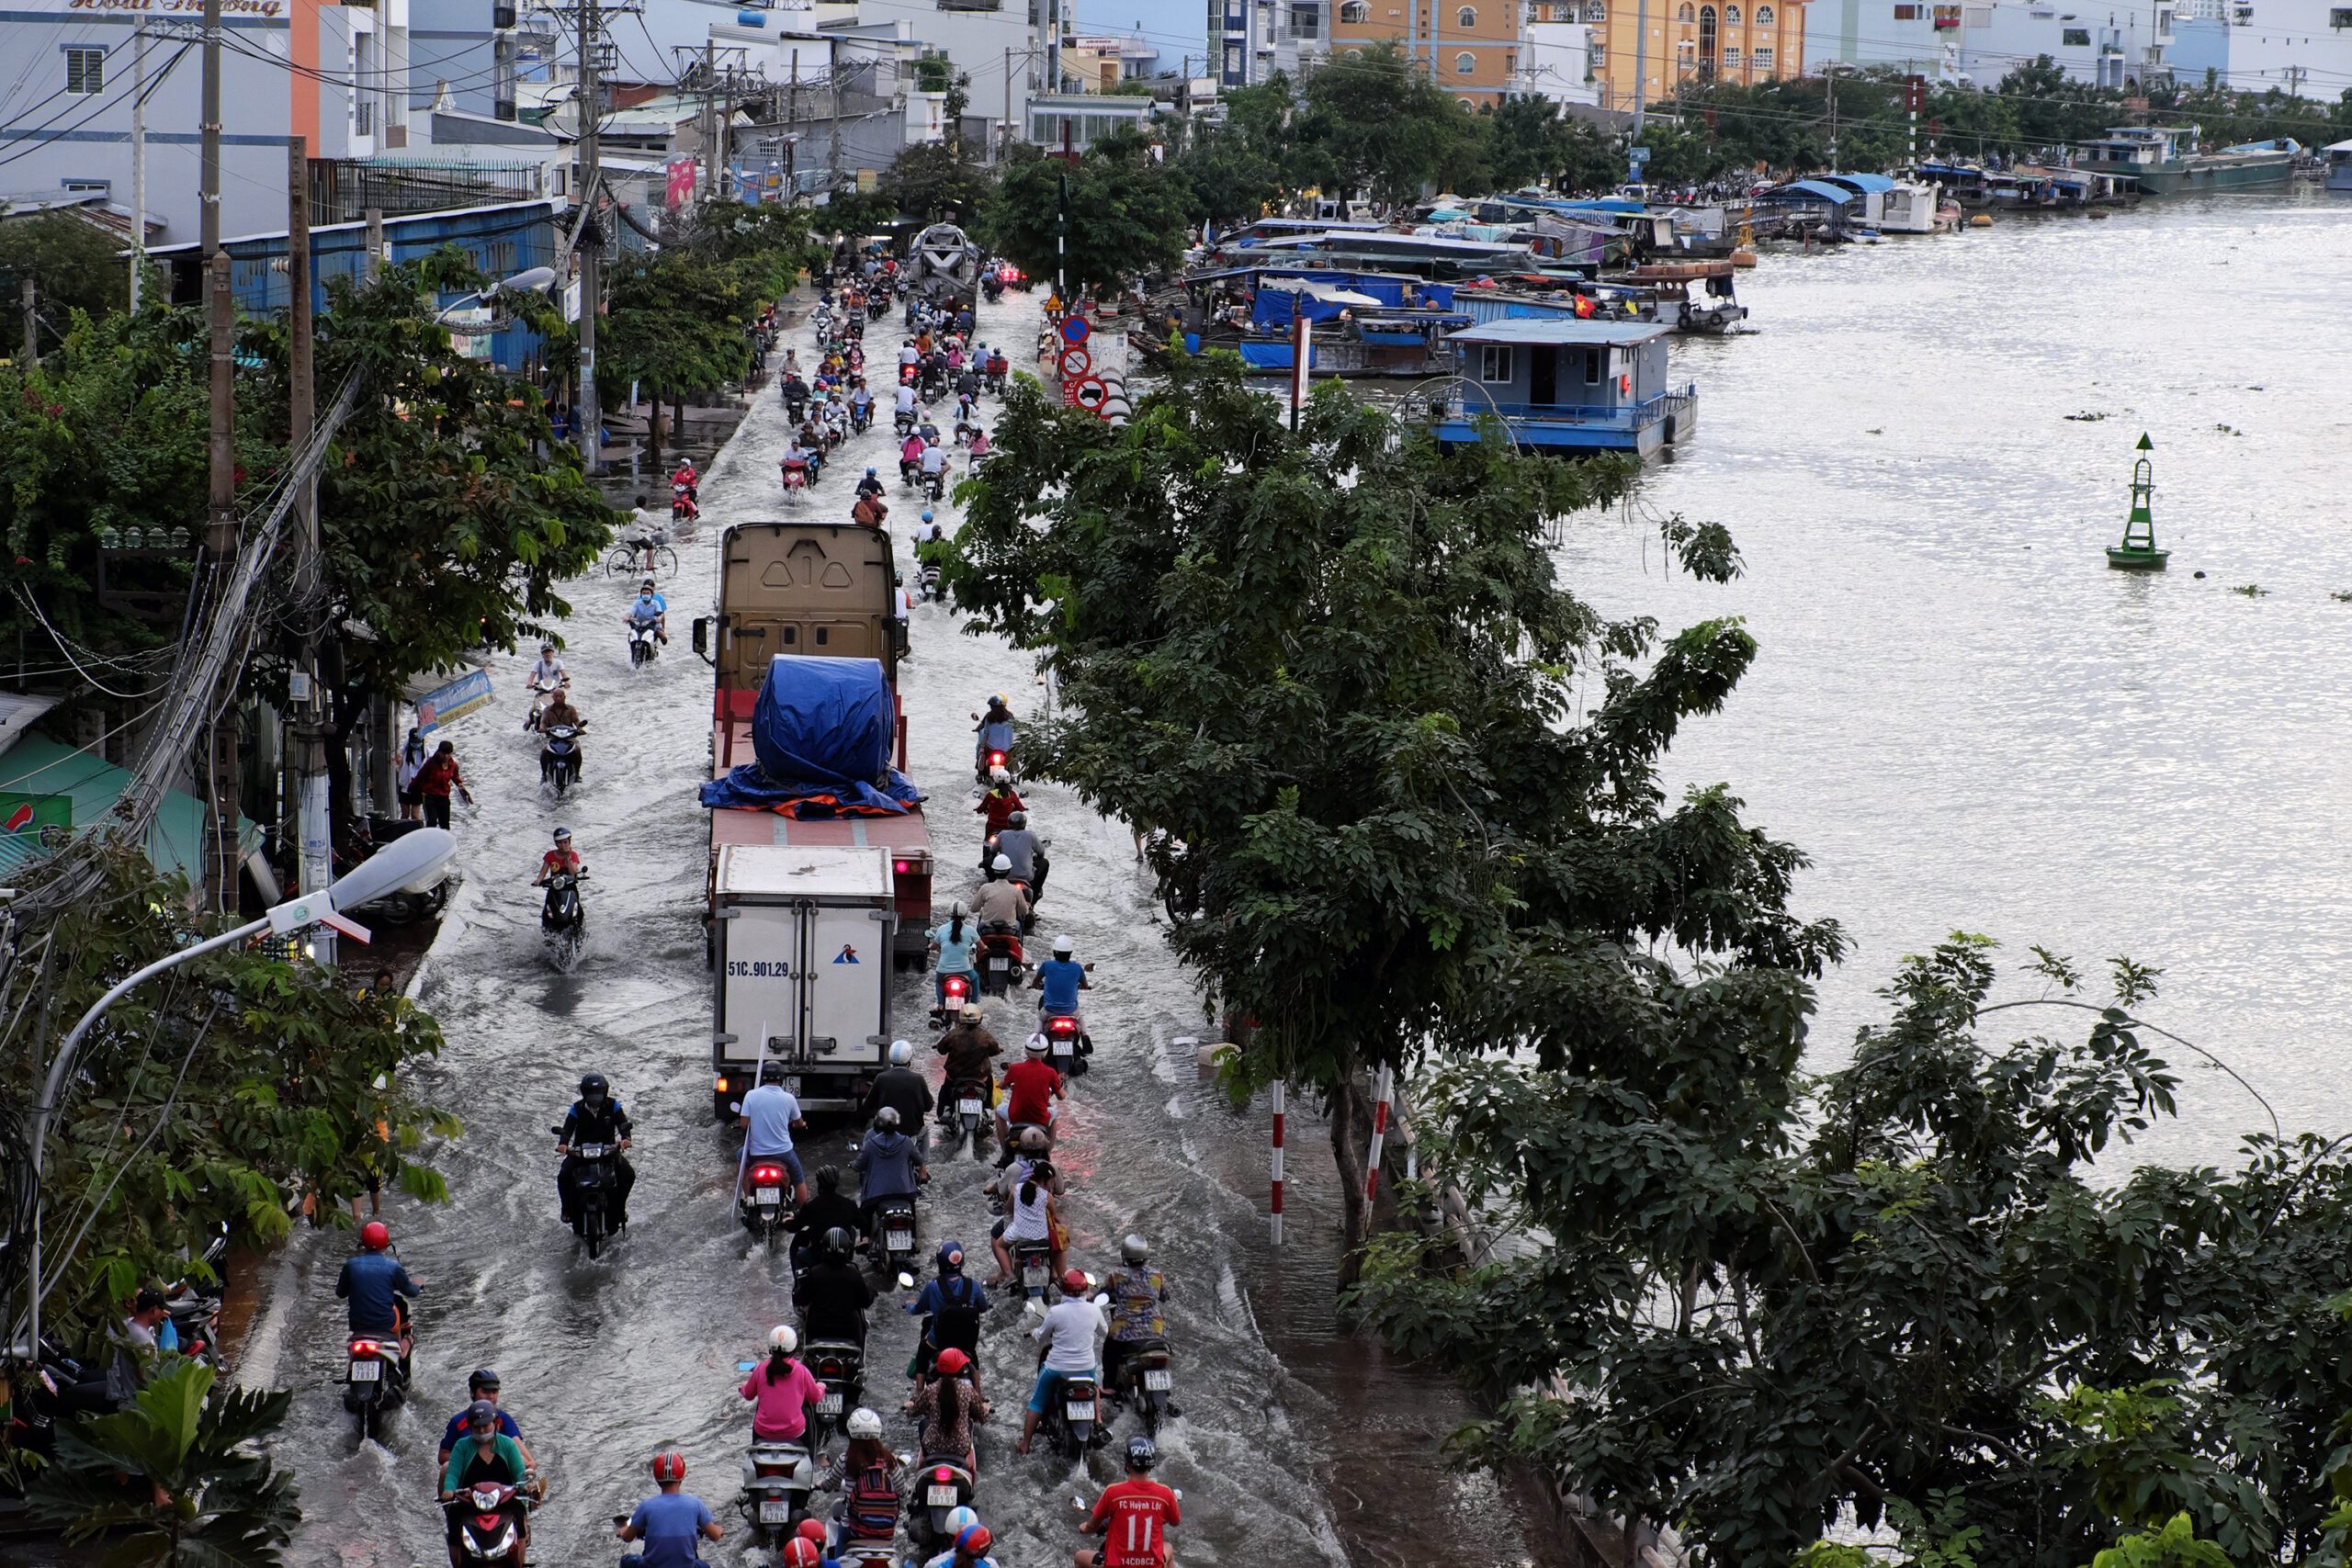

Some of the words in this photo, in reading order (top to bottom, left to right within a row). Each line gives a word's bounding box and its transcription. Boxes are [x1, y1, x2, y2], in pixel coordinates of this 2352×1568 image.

[728, 961, 788, 977] 51C.901.29
[1119, 1500, 1127, 1509] FC
[1127, 1514, 1153, 1551] 11
